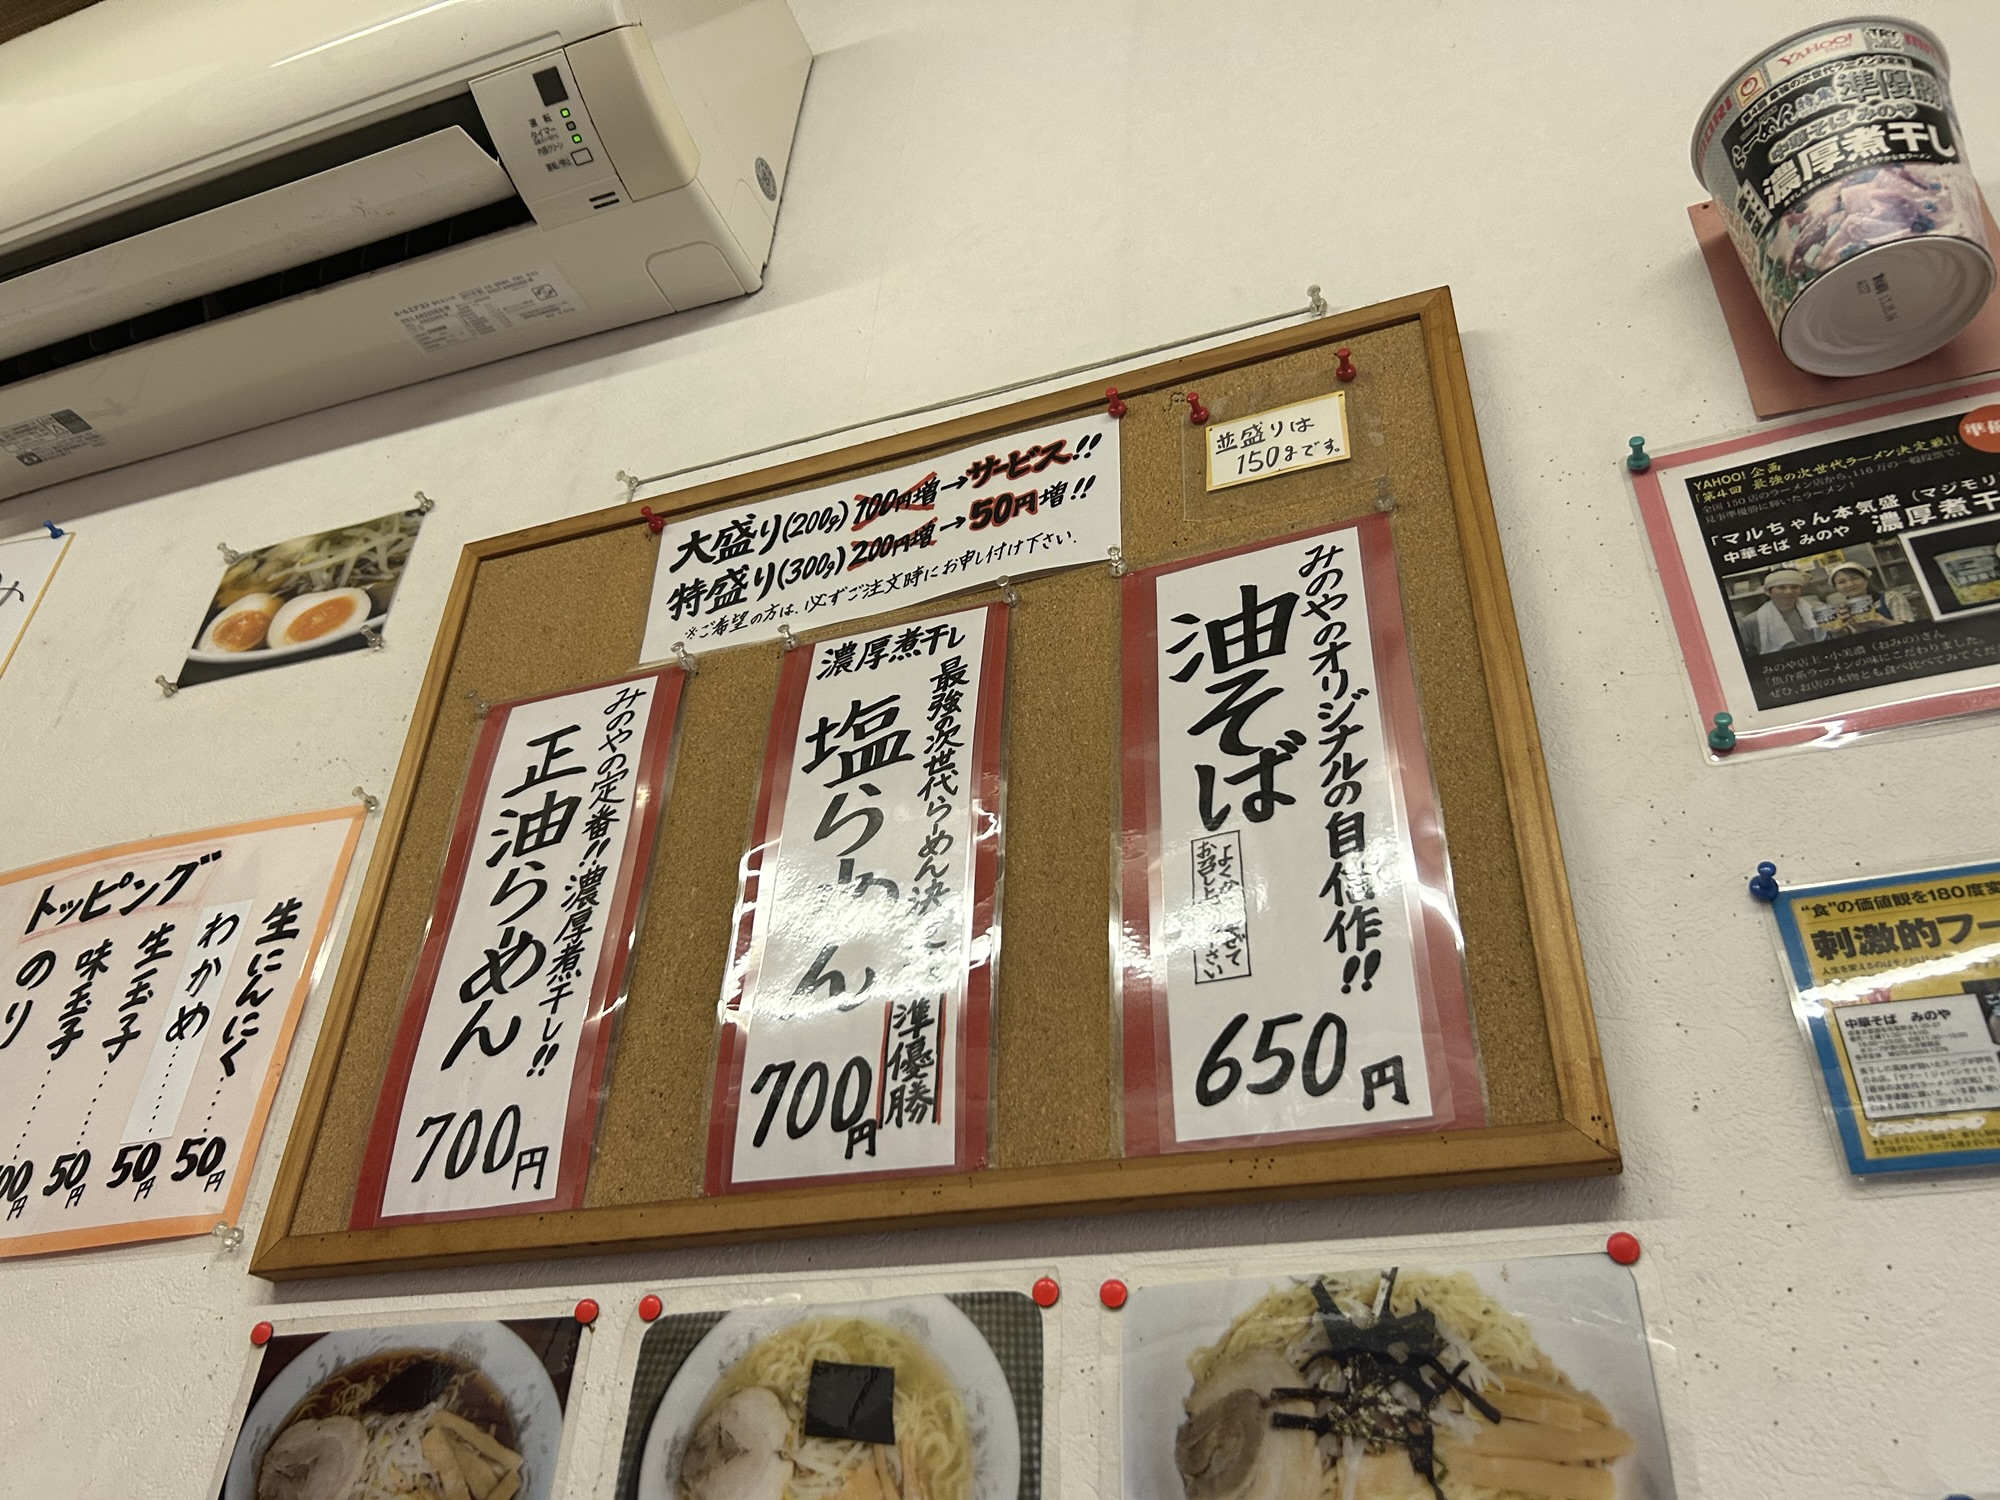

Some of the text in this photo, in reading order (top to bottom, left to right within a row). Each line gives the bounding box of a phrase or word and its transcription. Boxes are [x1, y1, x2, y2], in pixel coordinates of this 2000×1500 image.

[1777, 33, 1853, 67] YAHOO!
[531, 127, 556, 139] タイマー
[1762, 121, 1956, 210] 濃厚煮干し
[1771, 110, 1849, 161] 中華そば
[1856, 103, 1916, 120] みのや
[1215, 417, 1315, 455] 並盛りは
[1693, 461, 1783, 491] YAHOO! 企画
[669, 500, 850, 573] 大盛り(200g)
[967, 433, 1103, 488] サービス!!
[1723, 538, 1791, 564] 中華そば
[1799, 525, 1850, 546] みのや
[666, 546, 847, 622] 特盛り(300g)
[816, 623, 967, 681] 濃厚煮干し
[1165, 584, 1307, 831] 油そば
[1298, 544, 1383, 994] みのやのオリジナルの自信作!!
[24, 850, 223, 935] トッピング
[440, 724, 587, 1071] 正油らーめん
[1810, 913, 2000, 961] 刺激的フー
[46, 938, 112, 1061] 味玉子
[1844, 1014, 1898, 1029] 中華そば
[1911, 1008, 1951, 1023] みのや
[42, 923, 175, 1209] 生玉子 50円
[106, 911, 240, 1202] わかめ 50円
[170, 897, 303, 1192] 生にんにく 50円
[884, 997, 936, 1129] 準優勝
[1195, 1011, 1410, 1111] 650円
[411, 1104, 549, 1191] 700円
[750, 1056, 878, 1160] 700円
